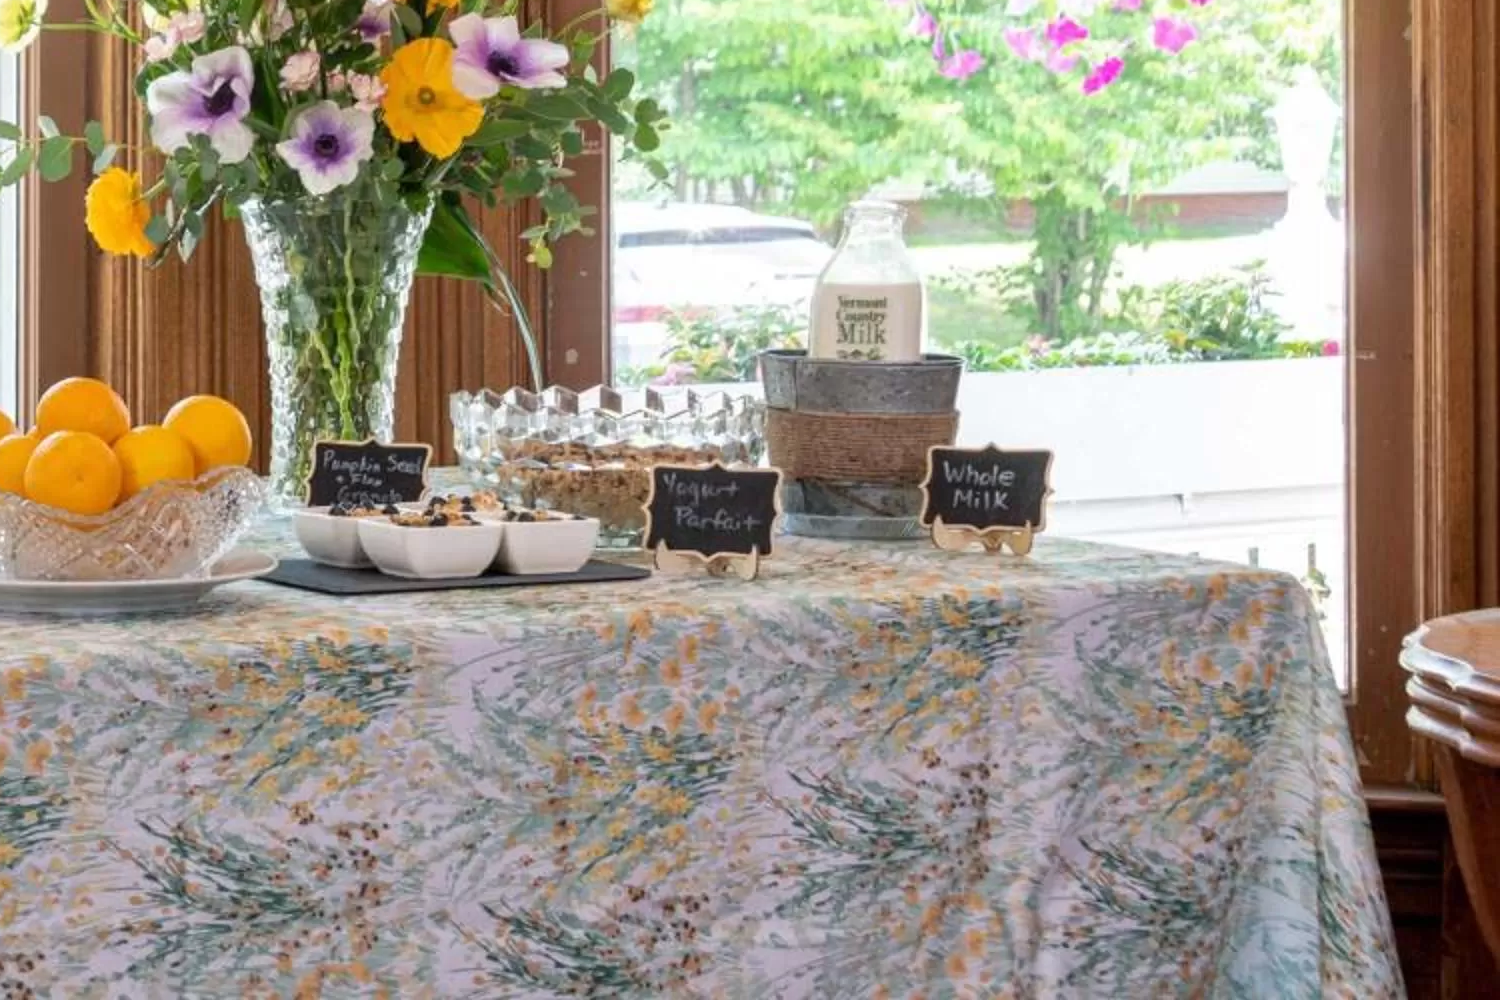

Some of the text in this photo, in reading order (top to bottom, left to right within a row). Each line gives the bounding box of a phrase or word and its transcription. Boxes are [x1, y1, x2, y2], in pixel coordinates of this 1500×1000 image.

[837, 296, 888, 308] Vermont
[836, 322, 886, 344] Milk
[943, 460, 1016, 487] Whole
[662, 472, 740, 507] Yogurt
[952, 488, 1009, 512] Milk
[674, 505, 762, 531] Parfait
